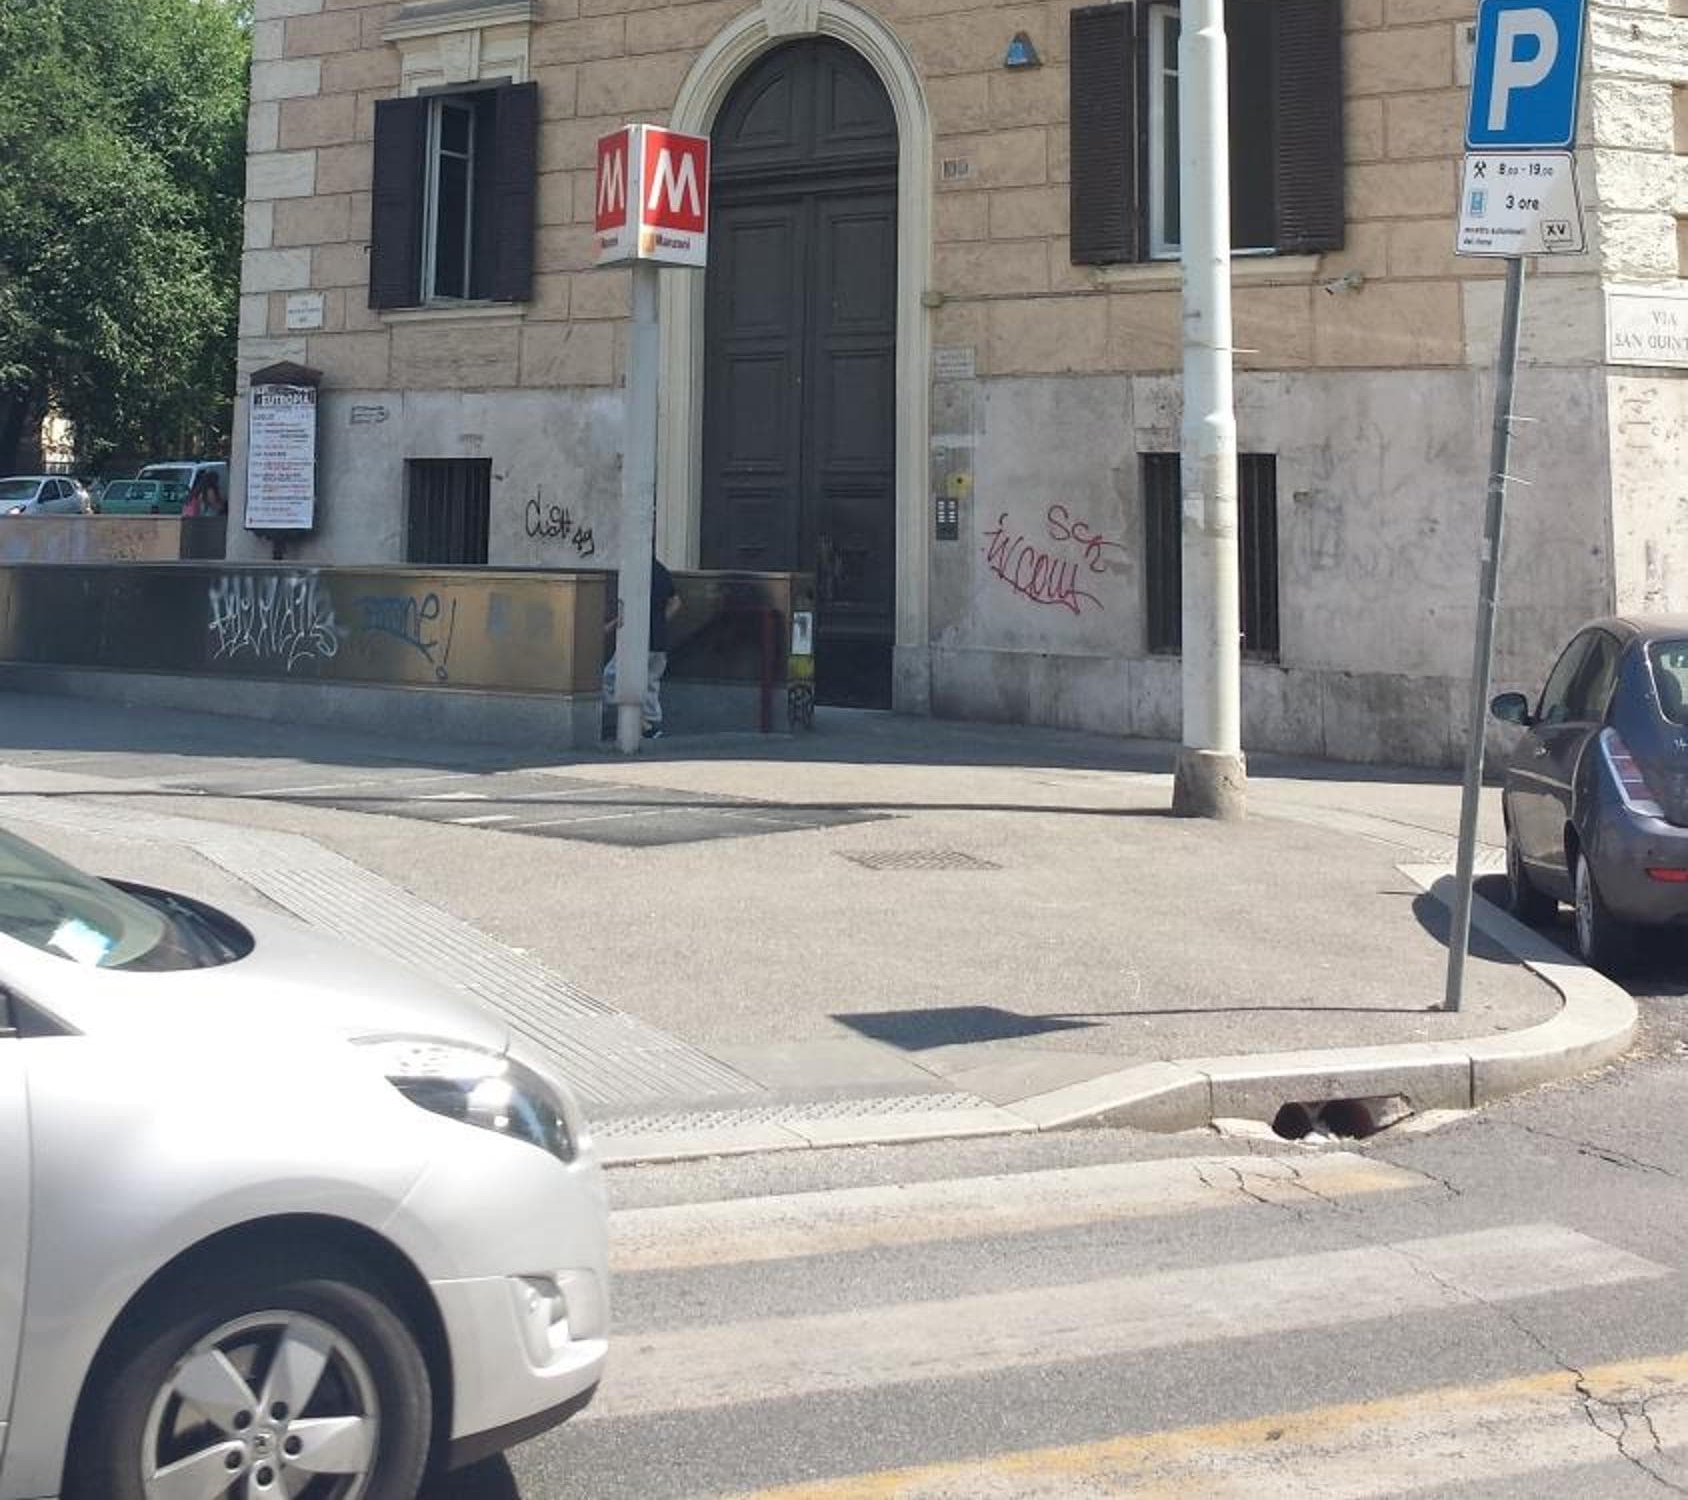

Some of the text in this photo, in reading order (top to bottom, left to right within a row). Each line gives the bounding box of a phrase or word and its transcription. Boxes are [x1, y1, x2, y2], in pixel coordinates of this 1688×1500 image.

[1486, 7, 1559, 132] P
[598, 148, 625, 217] M
[647, 148, 702, 218] M
[1505, 195, 1540, 211] 3 ore
[1652, 308, 1678, 325] VIA
[1615, 333, 1643, 349] SAN
